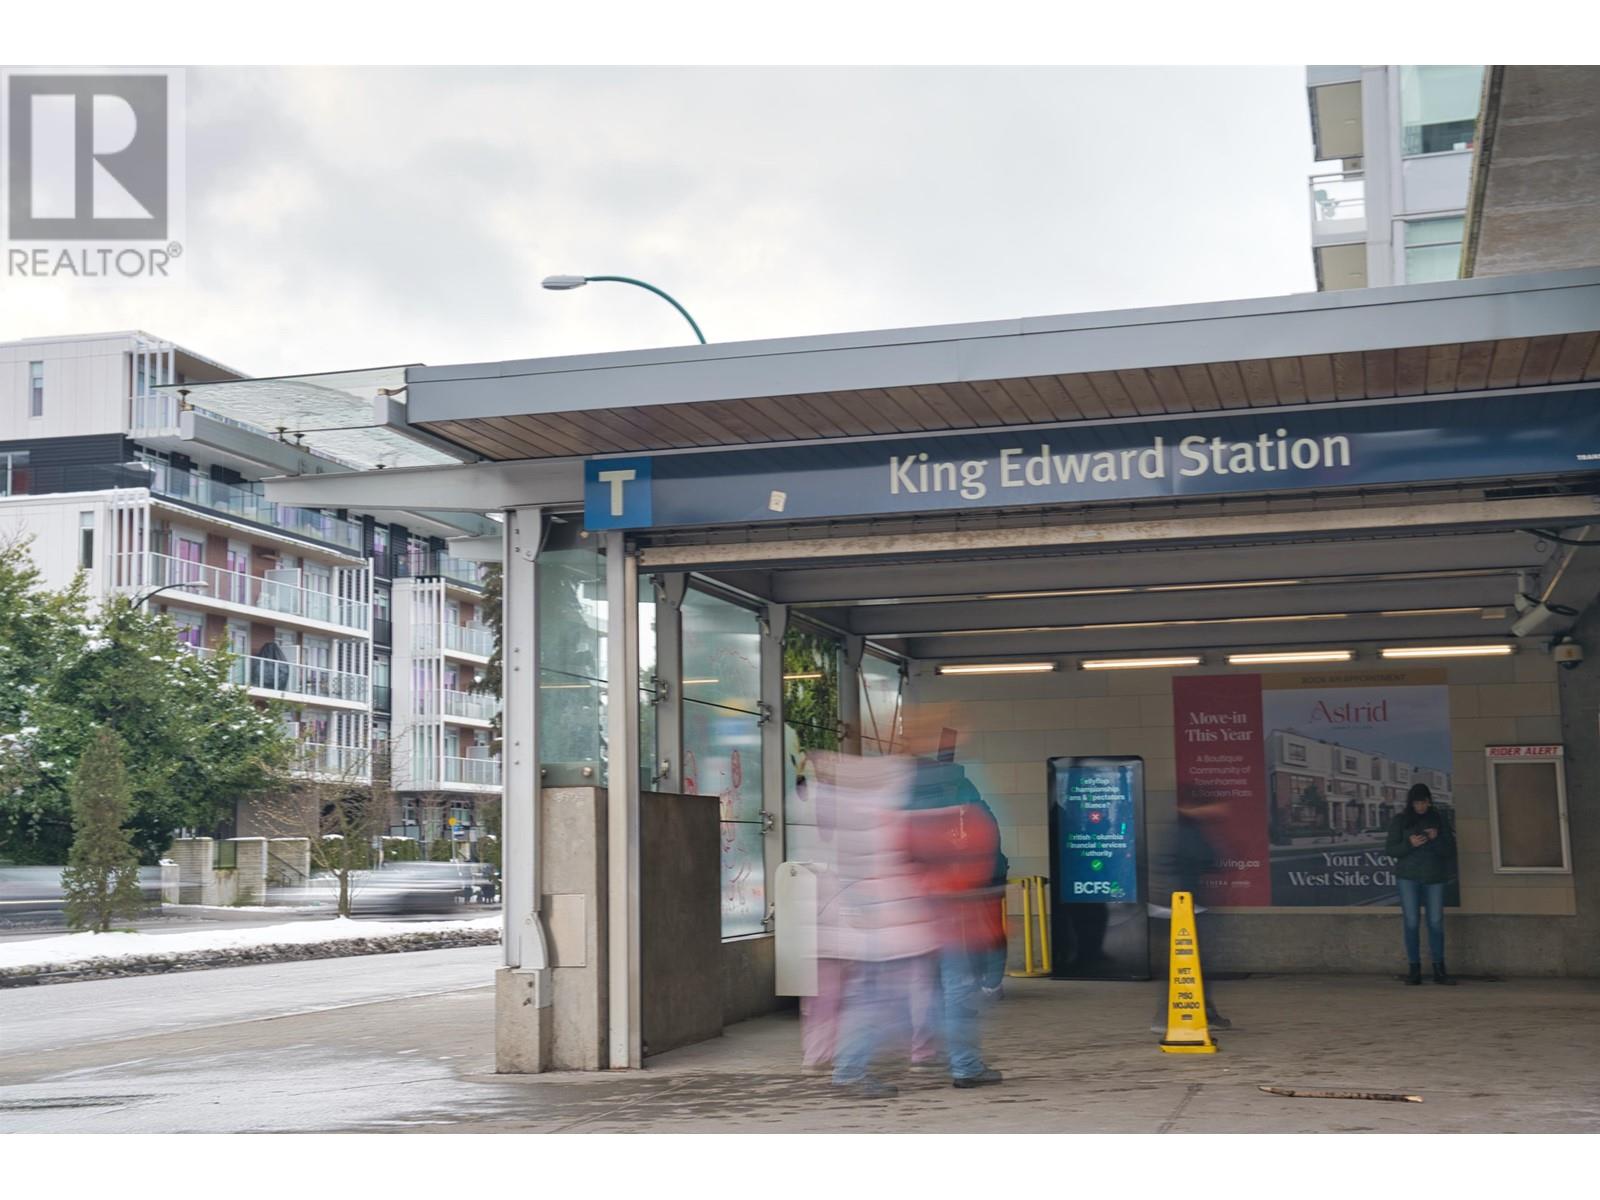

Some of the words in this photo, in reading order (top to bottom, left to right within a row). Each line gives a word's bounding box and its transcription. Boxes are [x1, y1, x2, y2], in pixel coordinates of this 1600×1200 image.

[889, 452, 988, 500] King
[1000, 436, 1165, 489] Edward
[1179, 428, 1351, 476] Station
[598, 469, 637, 517] T
[1189, 711, 1247, 725] Move-in
[1310, 700, 1388, 723] Astrid
[1184, 728, 1218, 742] This
[1220, 727, 1253, 741] Year
[1489, 747, 1520, 755] RIDER
[1525, 747, 1558, 755] ALERT
[1189, 767, 1241, 775] Community
[1241, 766, 1251, 774] of
[1322, 853, 1361, 867] Your
[1288, 871, 1330, 886] West
[1333, 870, 1370, 886] Side
[1174, 977, 1195, 985] FLOOR
